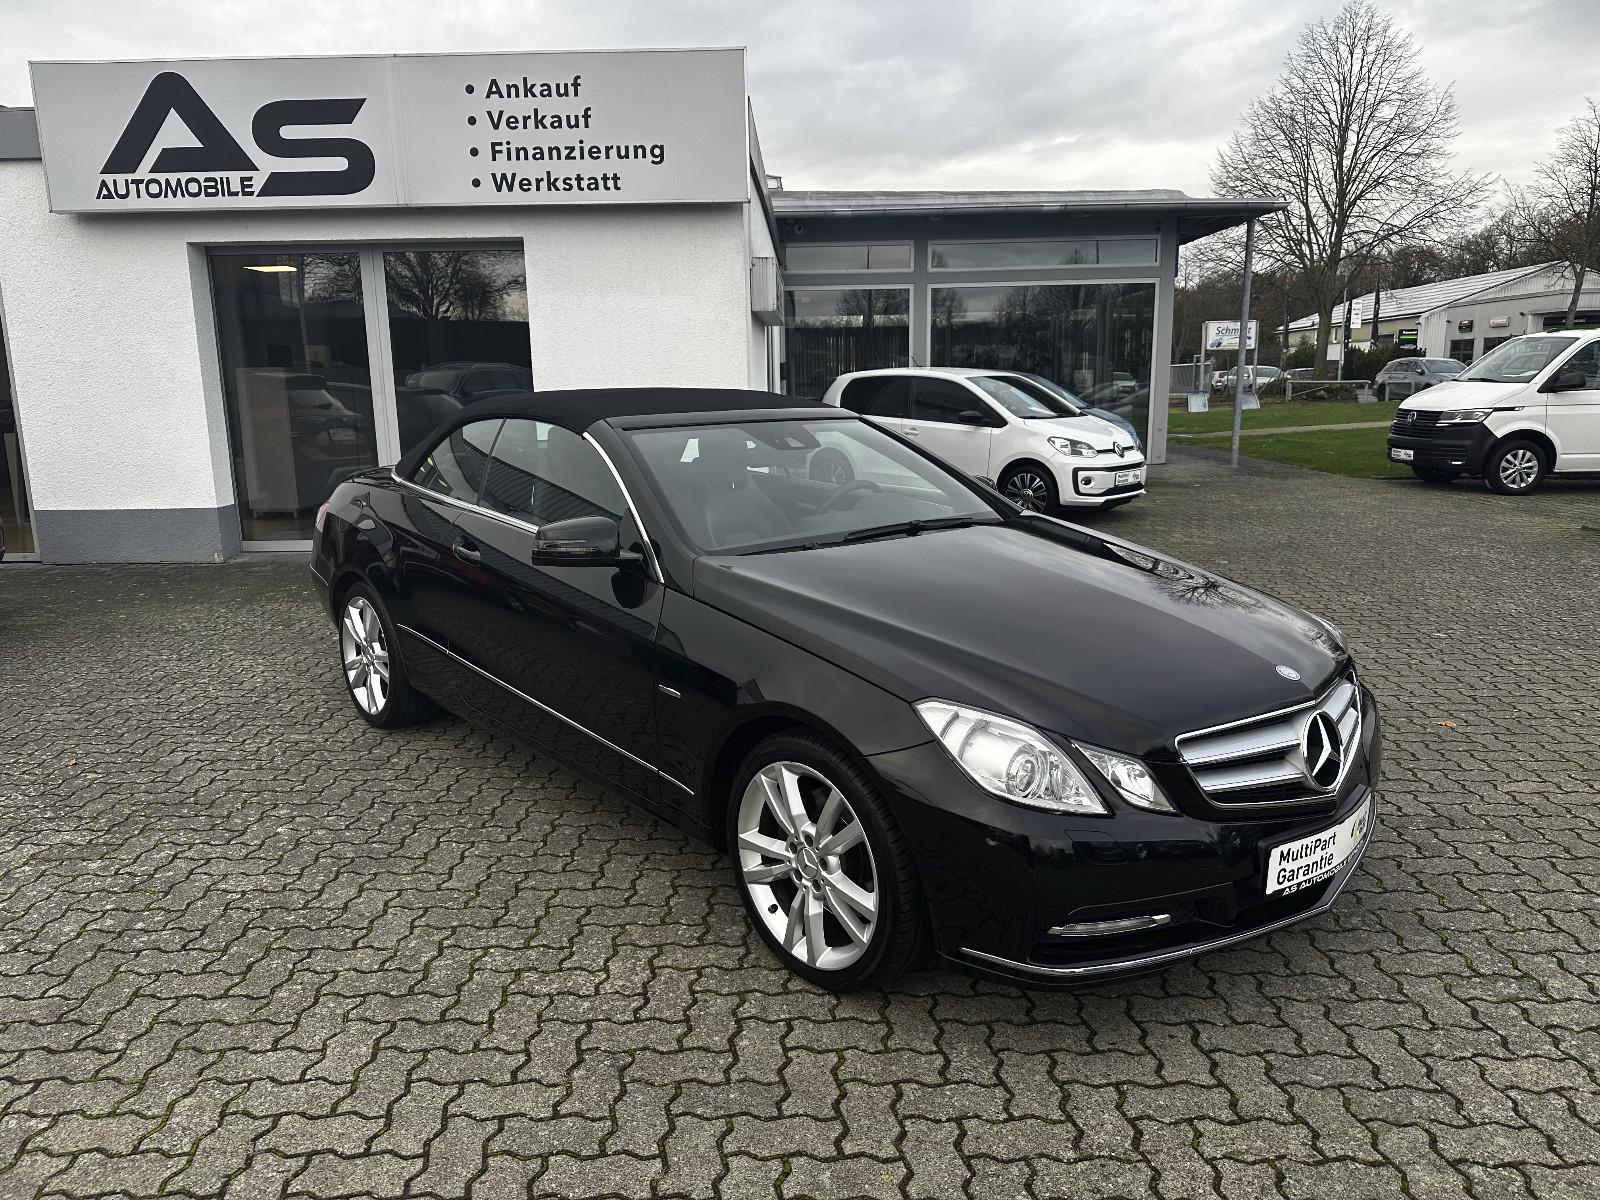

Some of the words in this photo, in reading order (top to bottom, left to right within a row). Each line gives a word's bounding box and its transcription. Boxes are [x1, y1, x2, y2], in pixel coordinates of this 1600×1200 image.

[485, 75, 581, 99] Ankauf
[486, 106, 592, 130] Verkauf
[99, 71, 376, 197] AS
[490, 139, 665, 165] Finanzierung
[96, 176, 255, 199] AUTOMOBILE
[491, 170, 621, 192] Werkstatt
[1215, 326, 1252, 335] Schmt
[1278, 831, 1337, 866] MultiPart
[1276, 851, 1334, 886] Garantie
[1282, 883, 1298, 896] AS
